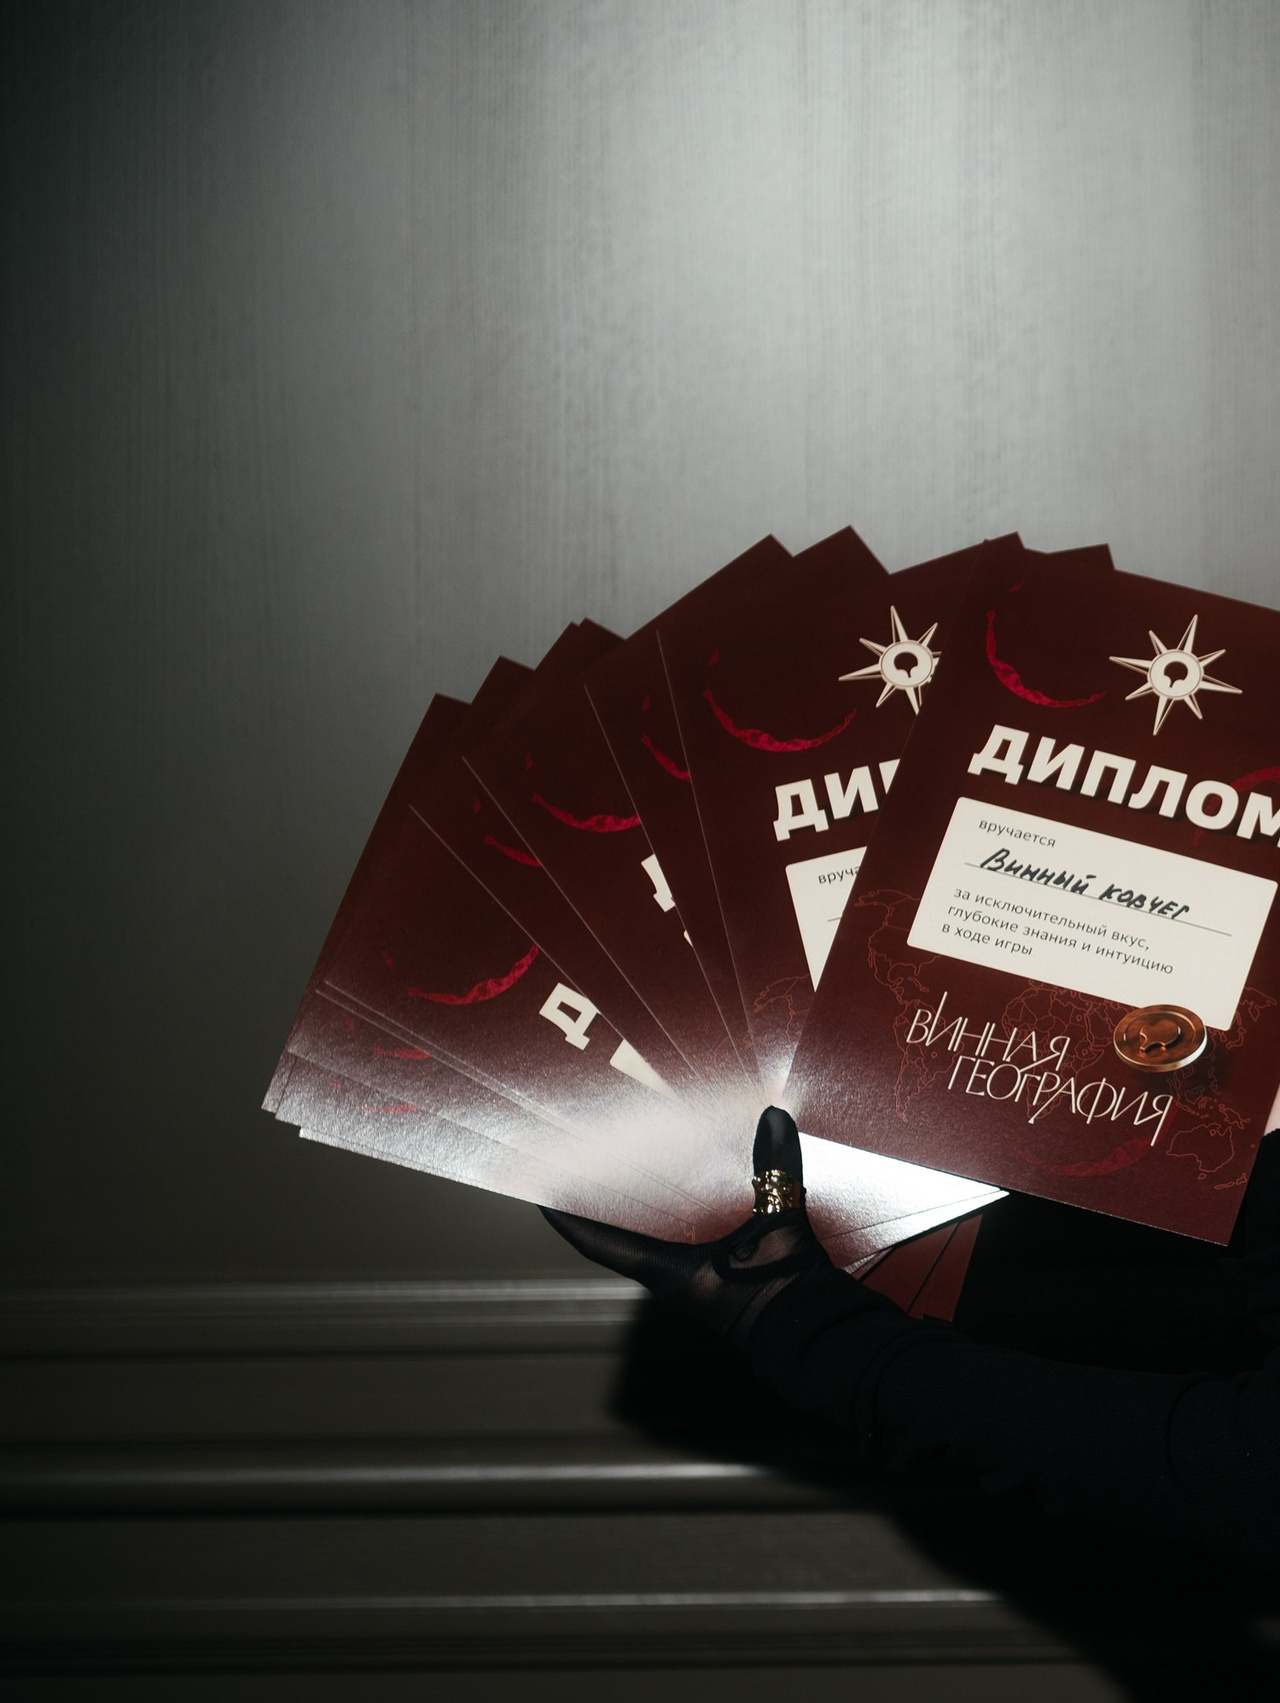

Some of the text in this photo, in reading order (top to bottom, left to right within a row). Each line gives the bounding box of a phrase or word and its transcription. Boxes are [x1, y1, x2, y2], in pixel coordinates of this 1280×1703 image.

[979, 819, 1056, 847] вручается
[980, 847, 1097, 895] Винный
[941, 923, 1033, 956] в ходе игры
[948, 905, 1174, 974] глубокие знания и интуицию
[953, 888, 1150, 951] за исключительный вкус,
[906, 991, 1070, 1072] ВИННАЯ
[947, 1055, 1174, 1147] ГЕОГРАФИЯ
